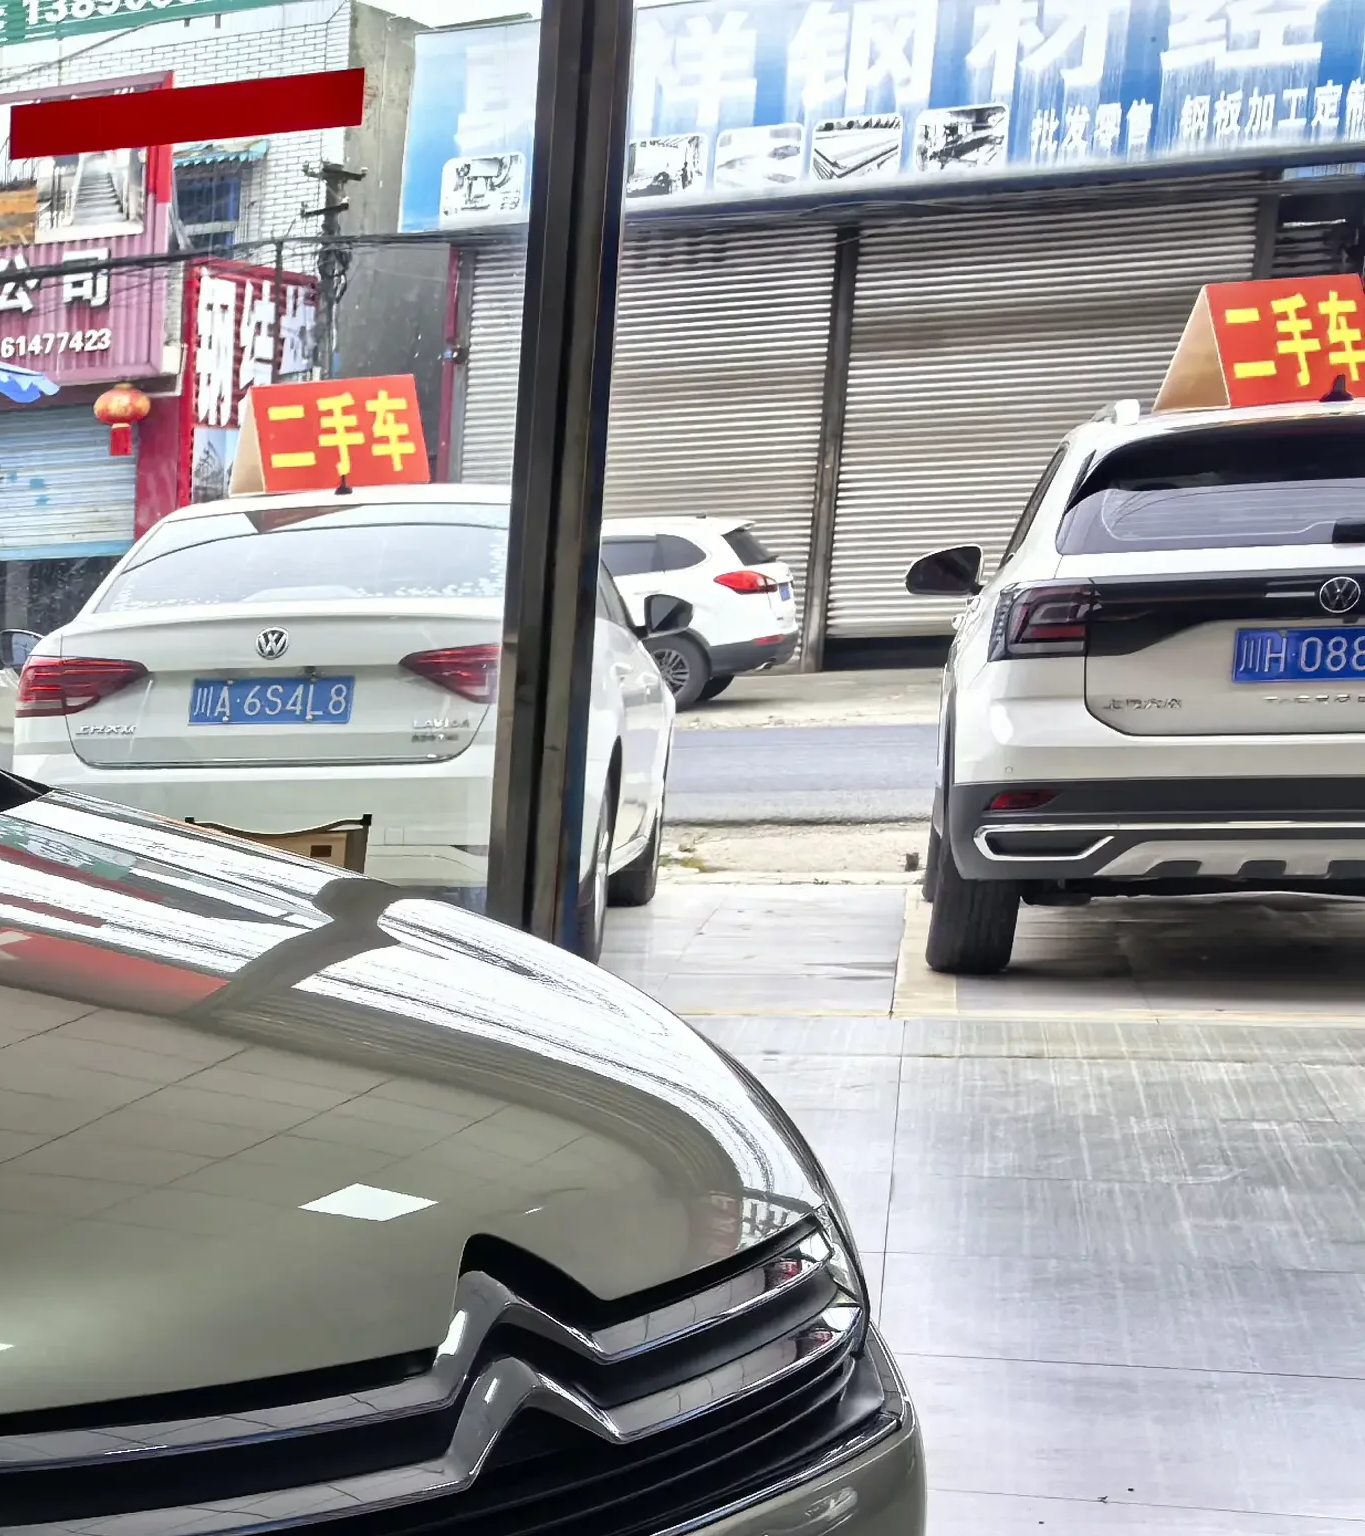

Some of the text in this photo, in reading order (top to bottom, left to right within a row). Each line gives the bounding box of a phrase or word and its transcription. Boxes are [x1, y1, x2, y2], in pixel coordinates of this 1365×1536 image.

[1031, 97, 1153, 163] 批发零售
[1225, 290, 1365, 387] 二手车
[267, 389, 417, 476] 二手车
